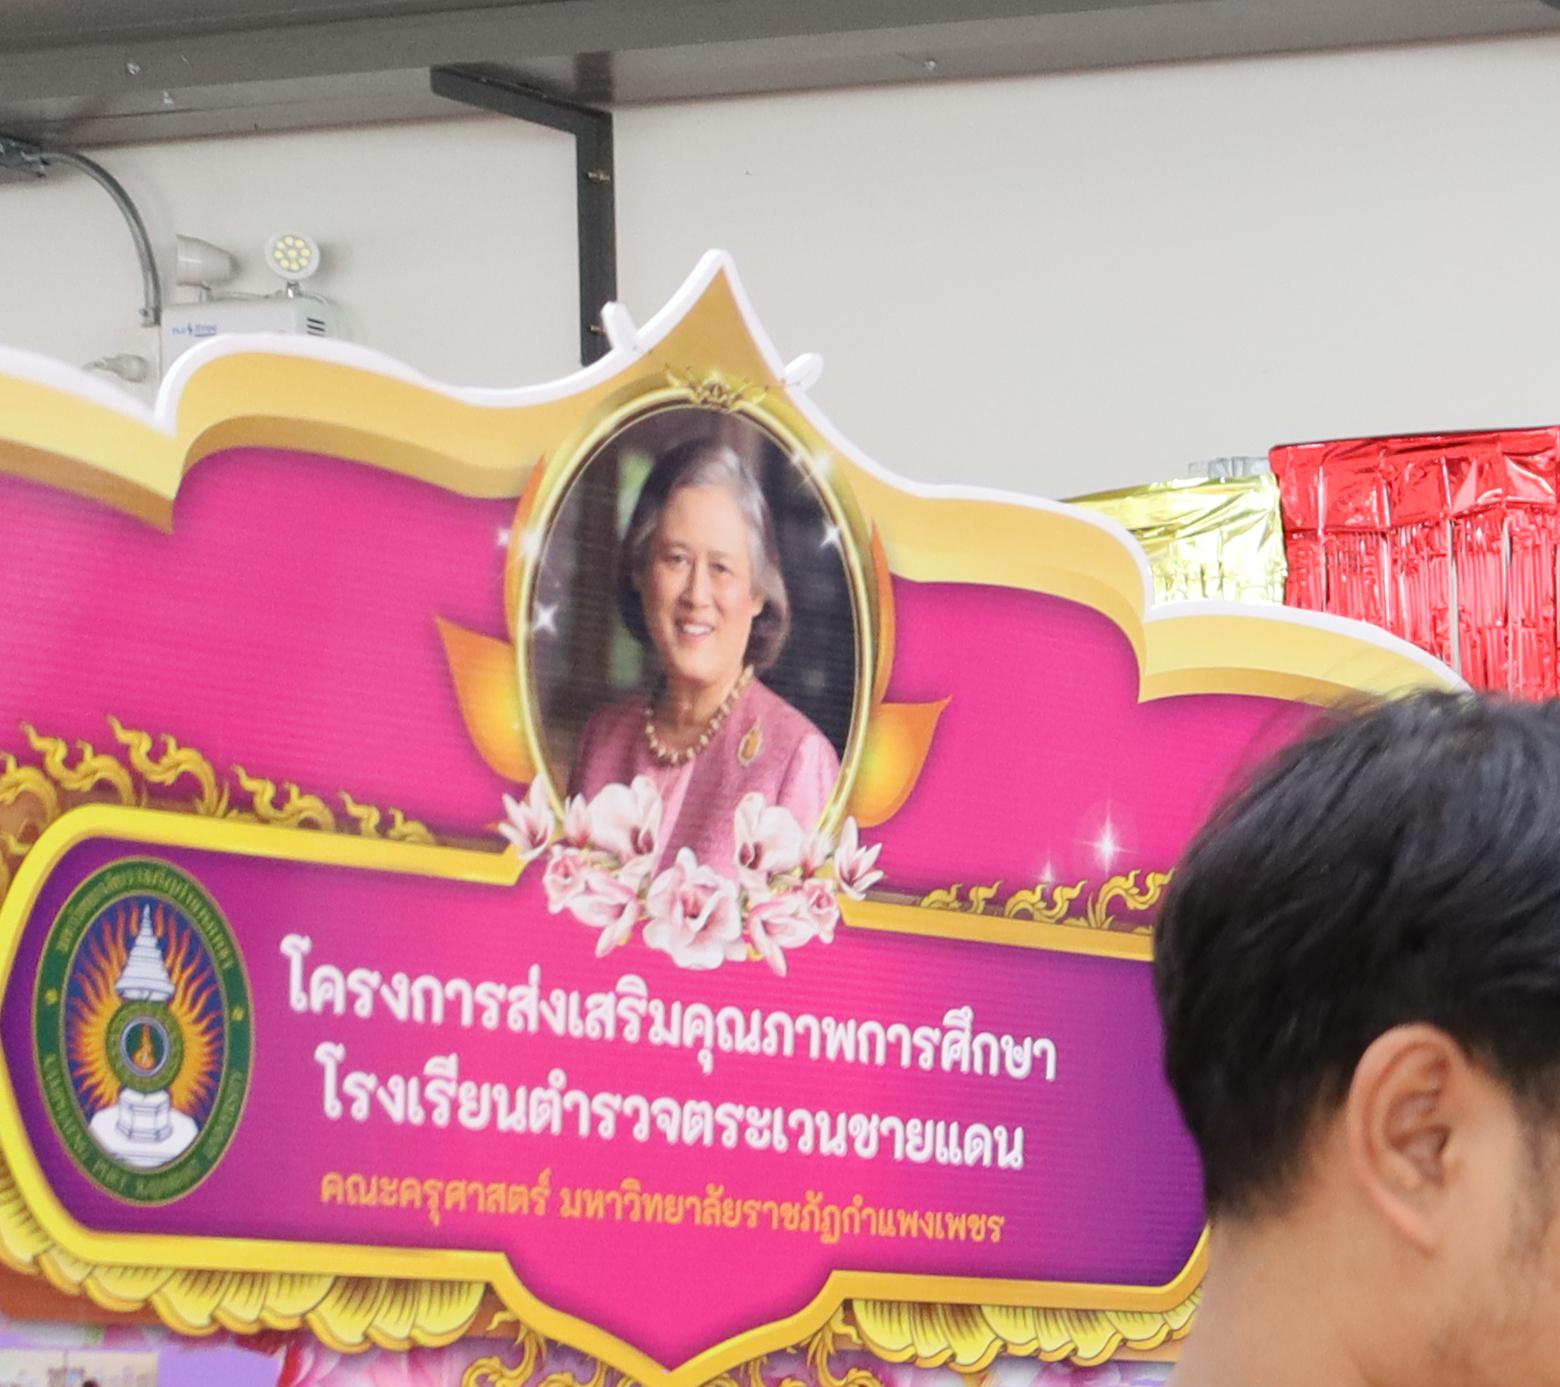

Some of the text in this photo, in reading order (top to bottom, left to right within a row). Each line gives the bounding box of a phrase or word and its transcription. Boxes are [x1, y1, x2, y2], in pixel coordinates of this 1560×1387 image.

[279, 932, 1058, 1081] โครงการส่งเสริมคุณภาพการศึกษา
[313, 1041, 1025, 1170] โรงเรียนตำรวจตระเวนชายแดน
[320, 1167, 1006, 1244] คณะครุศาสตร์ มหาวิทยาลัยราชภัฏกำแพงเพชร
